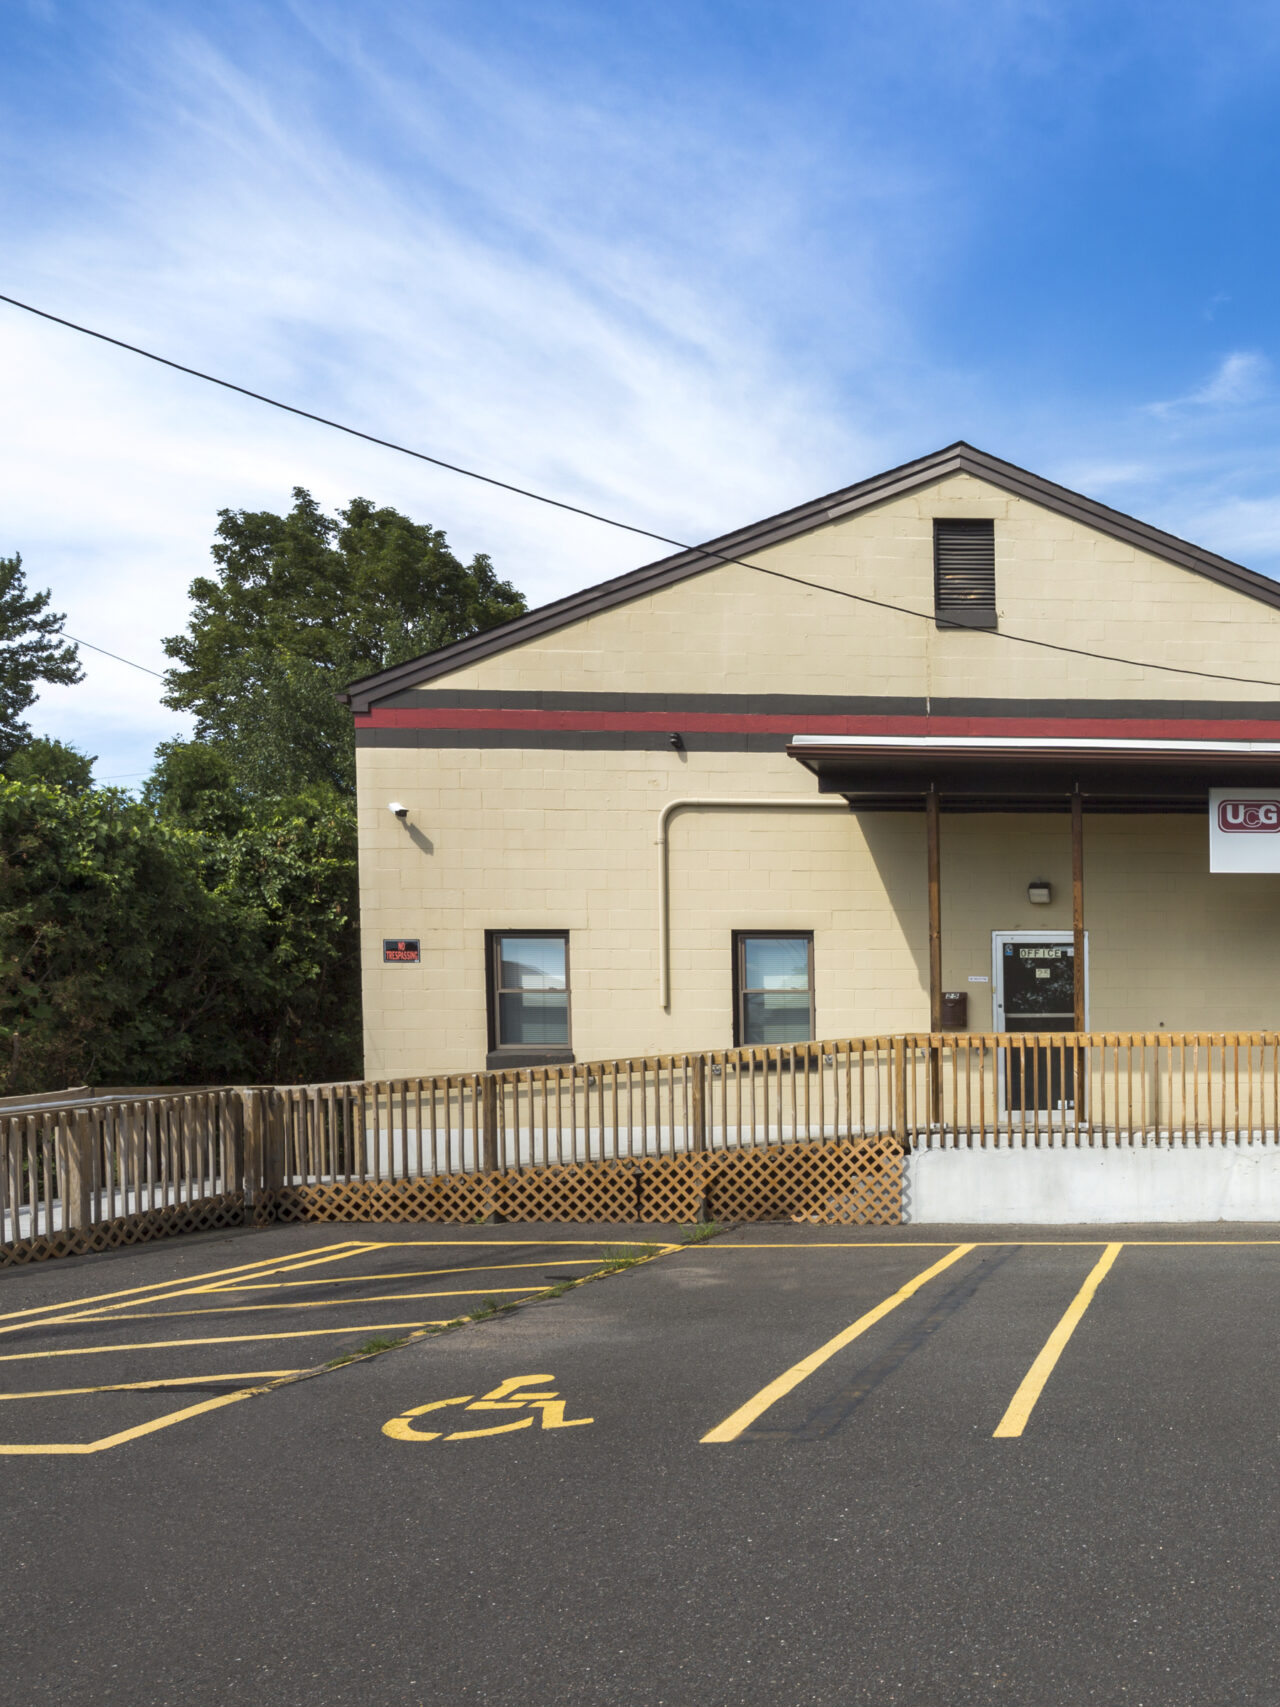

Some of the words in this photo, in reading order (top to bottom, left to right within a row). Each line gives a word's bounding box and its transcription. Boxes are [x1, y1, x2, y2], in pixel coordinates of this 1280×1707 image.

[397, 941, 406, 951] NO
[385, 950, 419, 960] TRESPASSING
[1020, 949, 1061, 958] OFFICE
